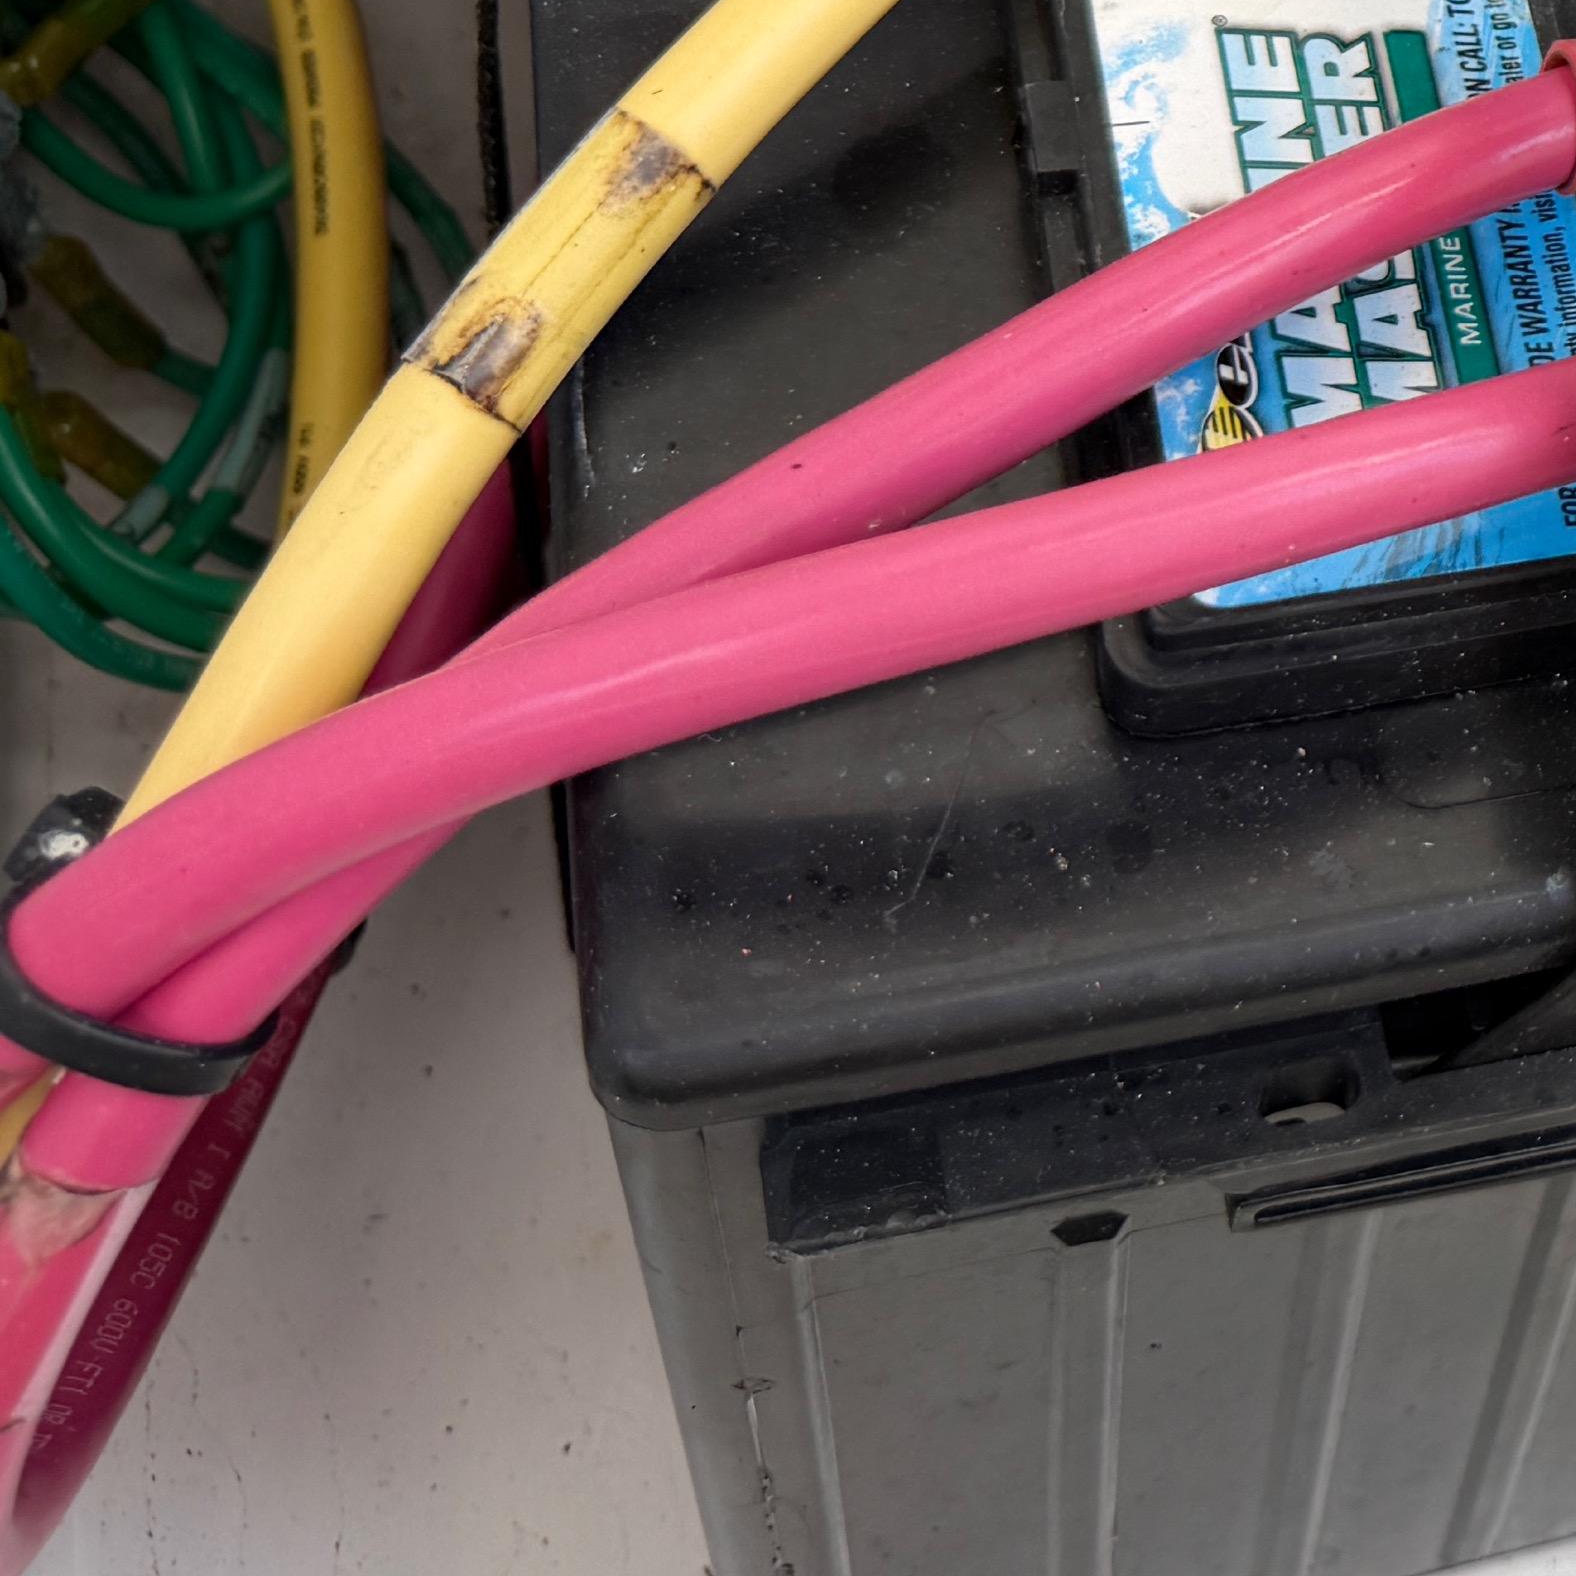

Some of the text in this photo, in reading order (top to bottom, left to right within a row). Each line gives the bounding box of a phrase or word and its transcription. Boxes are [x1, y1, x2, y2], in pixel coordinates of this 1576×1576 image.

[1490, 8, 1513, 33] go
[1496, 31, 1517, 60] or
[1438, 233, 1483, 346] MARINE
[1496, 218, 1549, 338] WARRANTY
[172, 1170, 217, 1220] A/B
[129, 1231, 183, 1291] 105C
